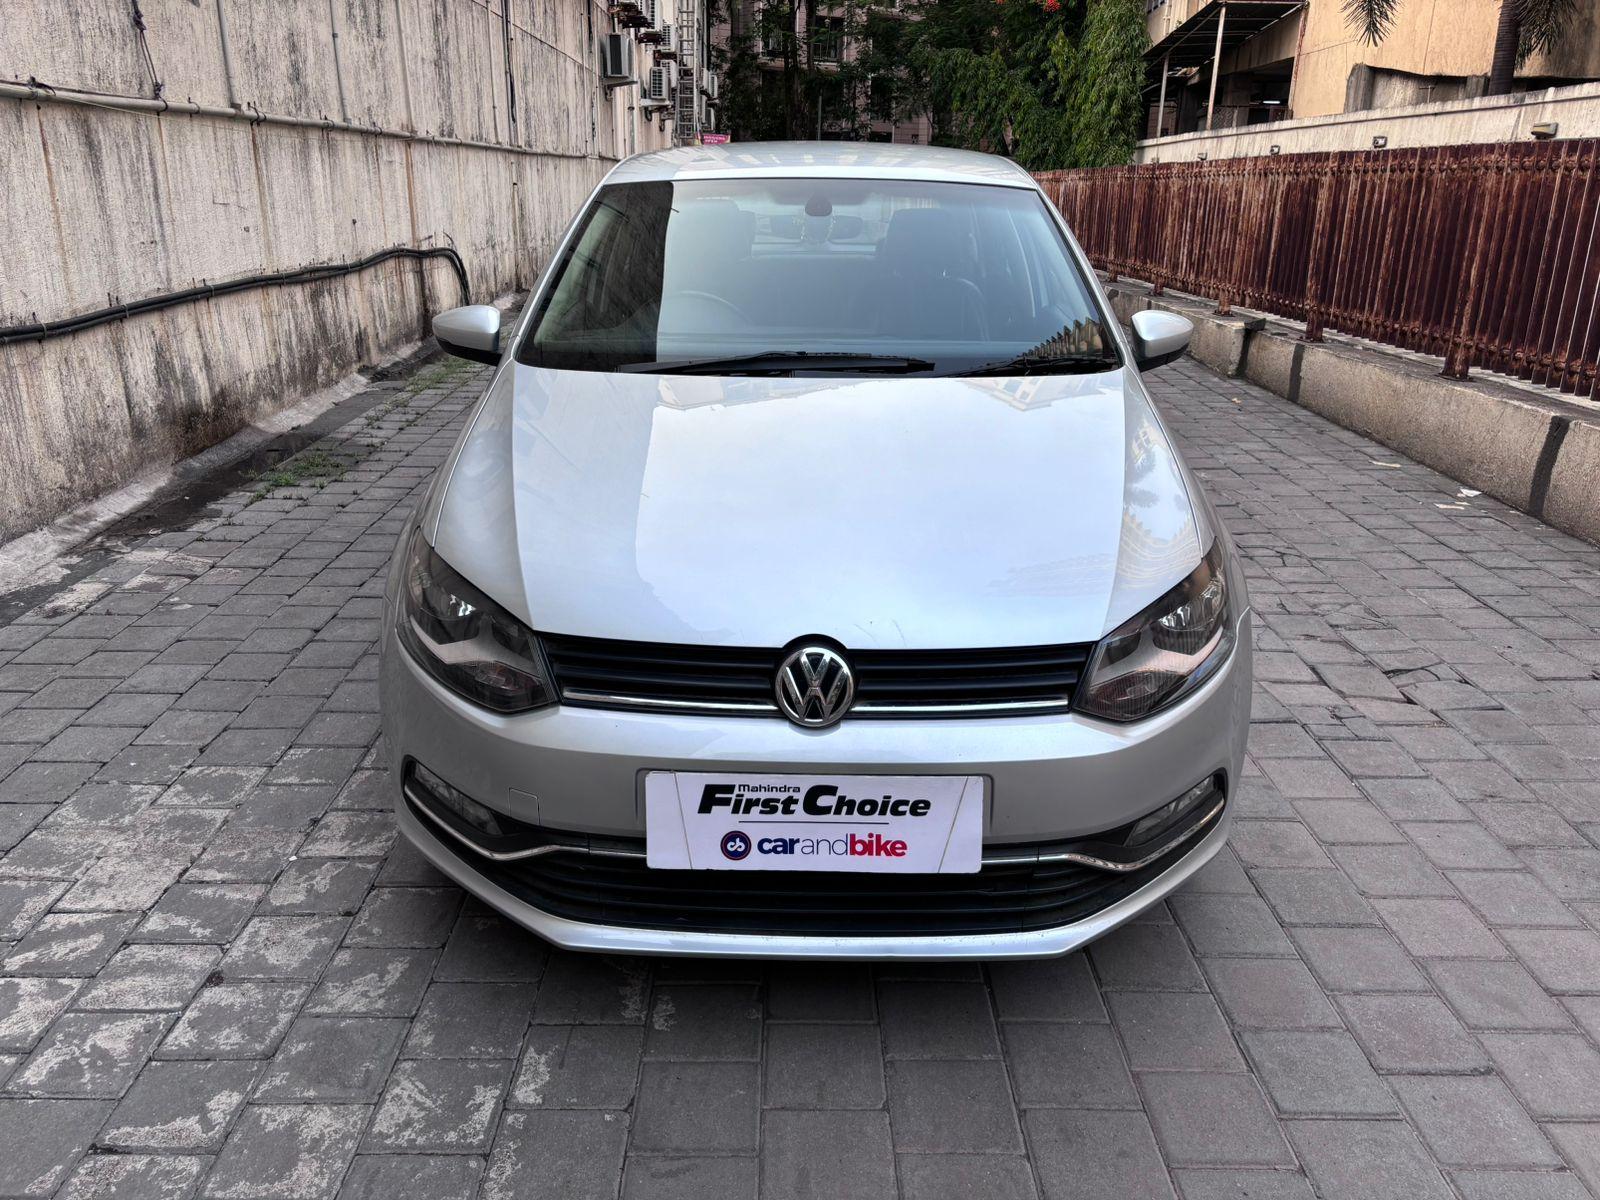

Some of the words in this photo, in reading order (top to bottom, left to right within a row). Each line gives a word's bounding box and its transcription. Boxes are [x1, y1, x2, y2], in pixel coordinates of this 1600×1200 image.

[777, 648, 852, 726] VW
[697, 784, 800, 814] First
[803, 784, 932, 816] Choice
[738, 784, 801, 793] Mahindra
[757, 832, 907, 857] carandbike
